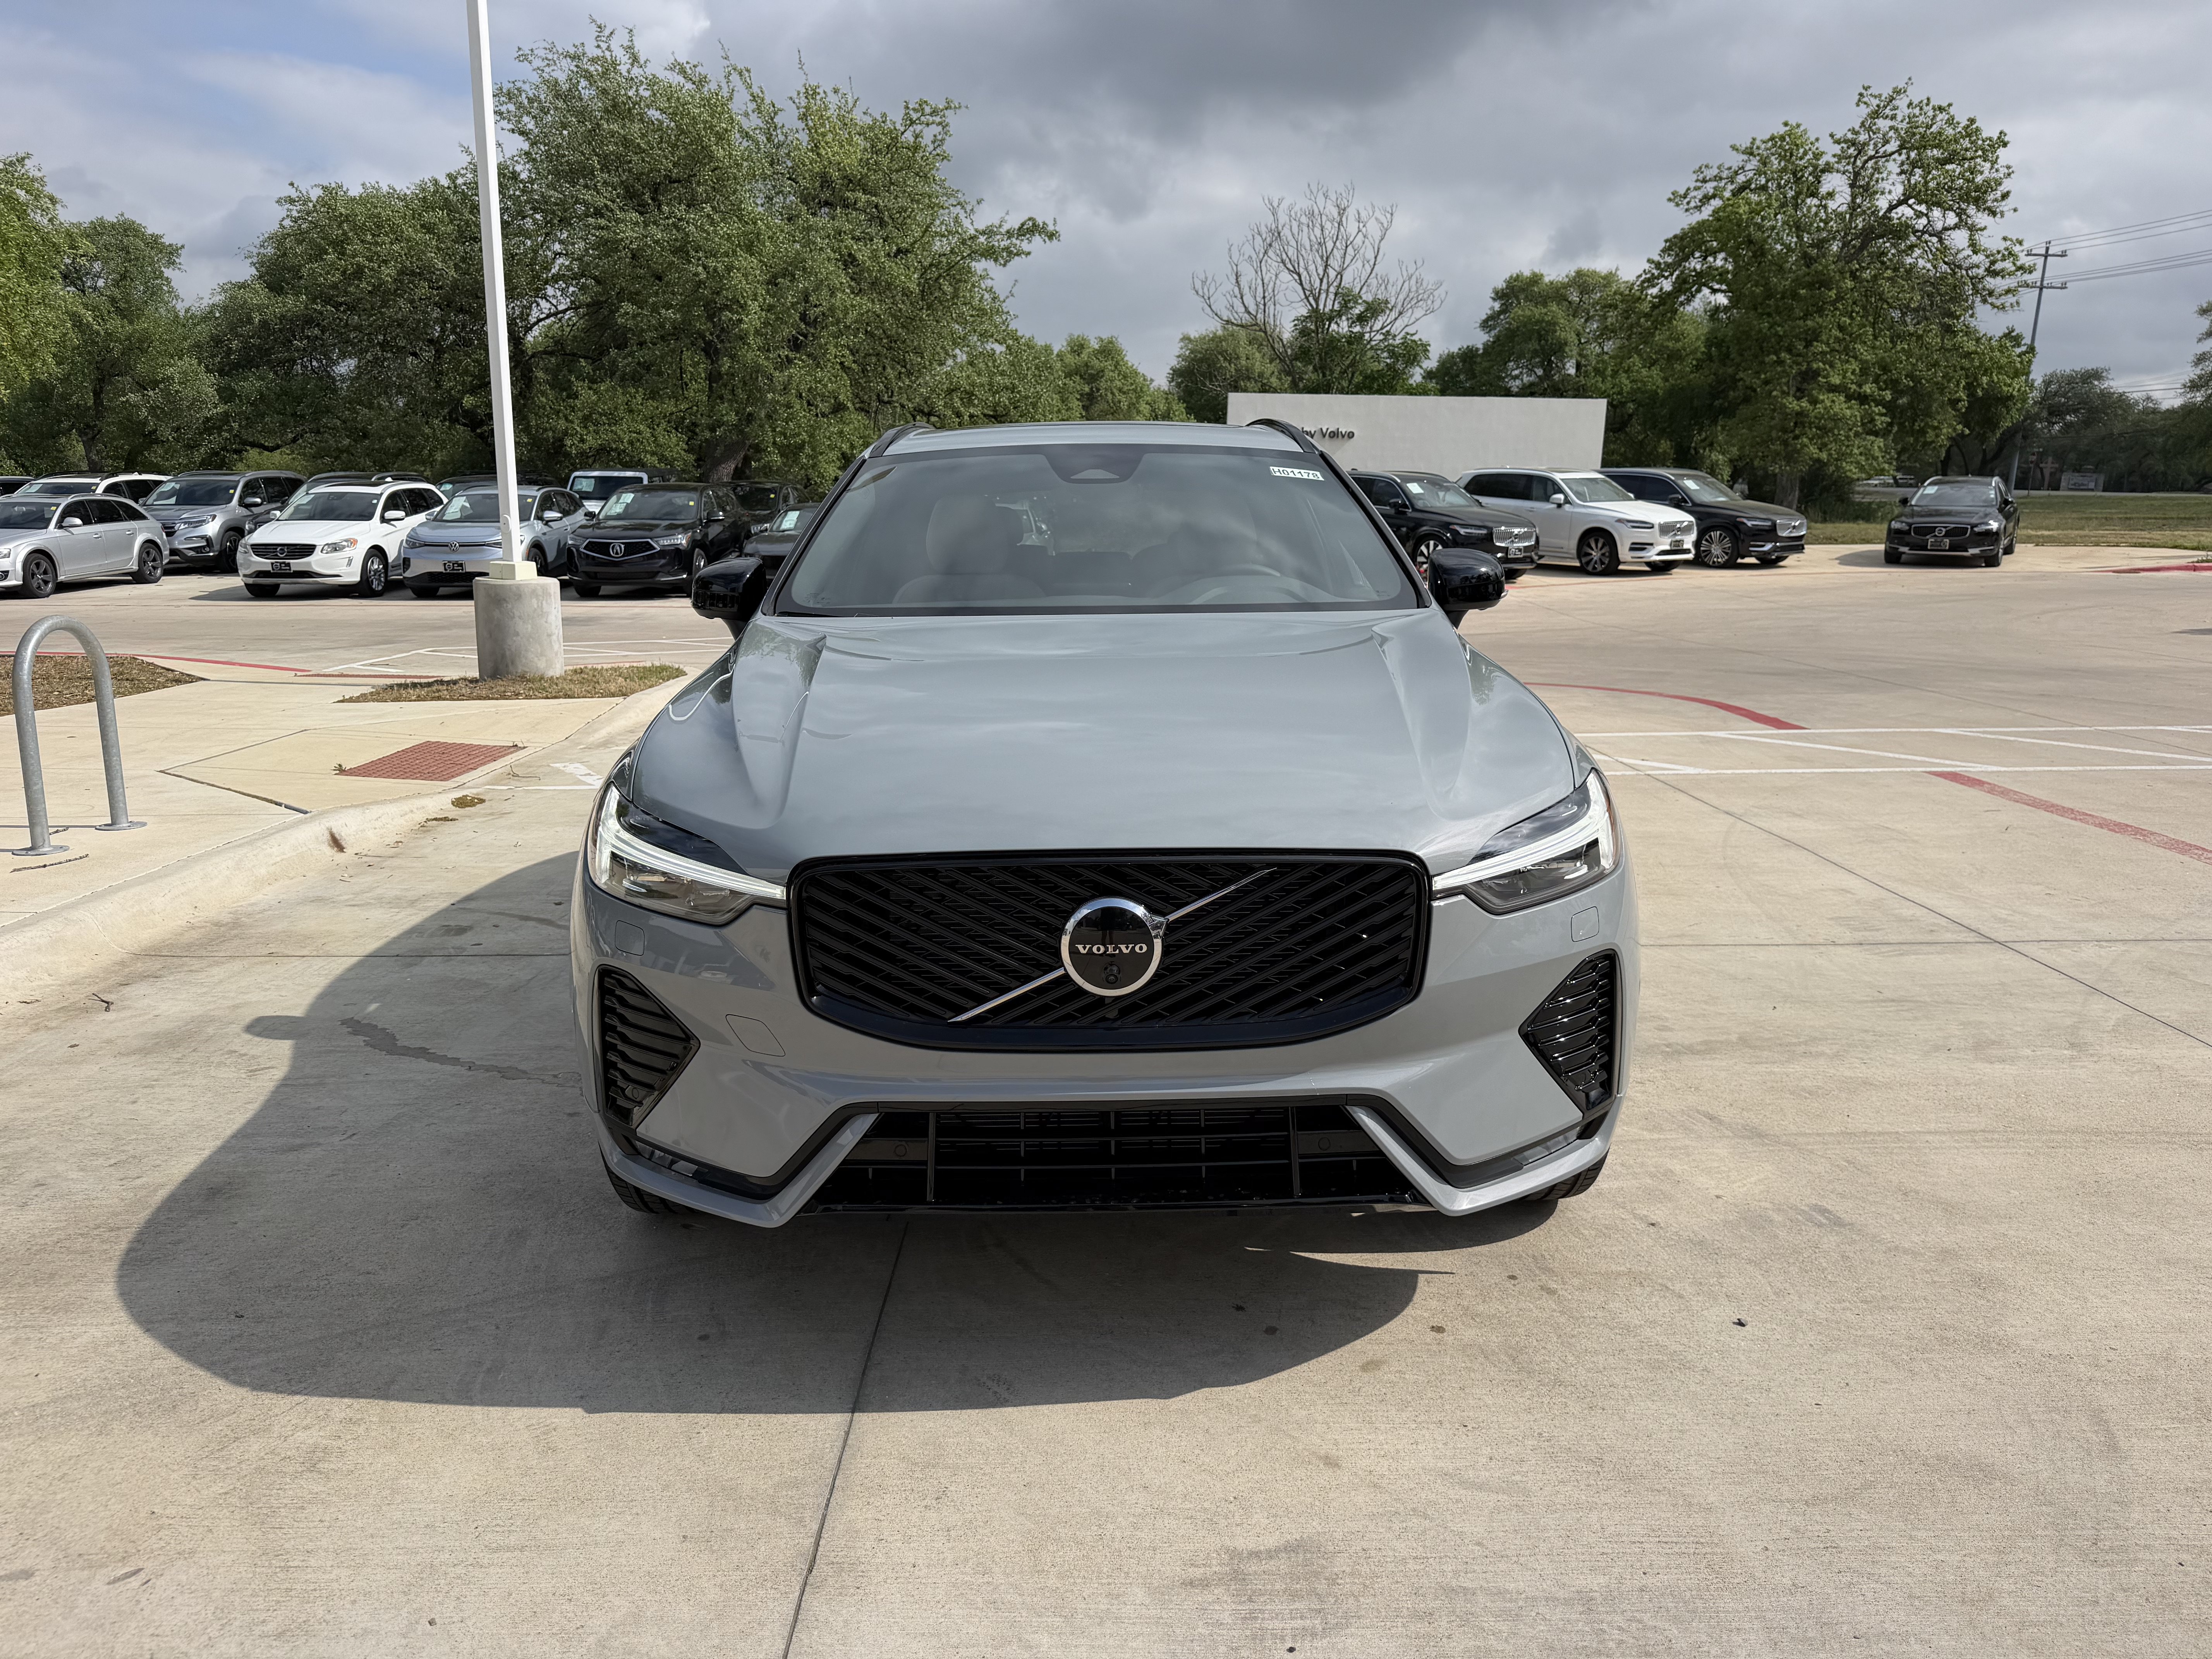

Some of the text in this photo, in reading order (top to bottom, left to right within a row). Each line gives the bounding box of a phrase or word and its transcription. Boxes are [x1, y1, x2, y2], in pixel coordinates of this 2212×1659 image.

[1321, 427, 1355, 439] Volvo
[1272, 468, 1320, 479] H01178
[1075, 943, 1147, 954] VOLVO
